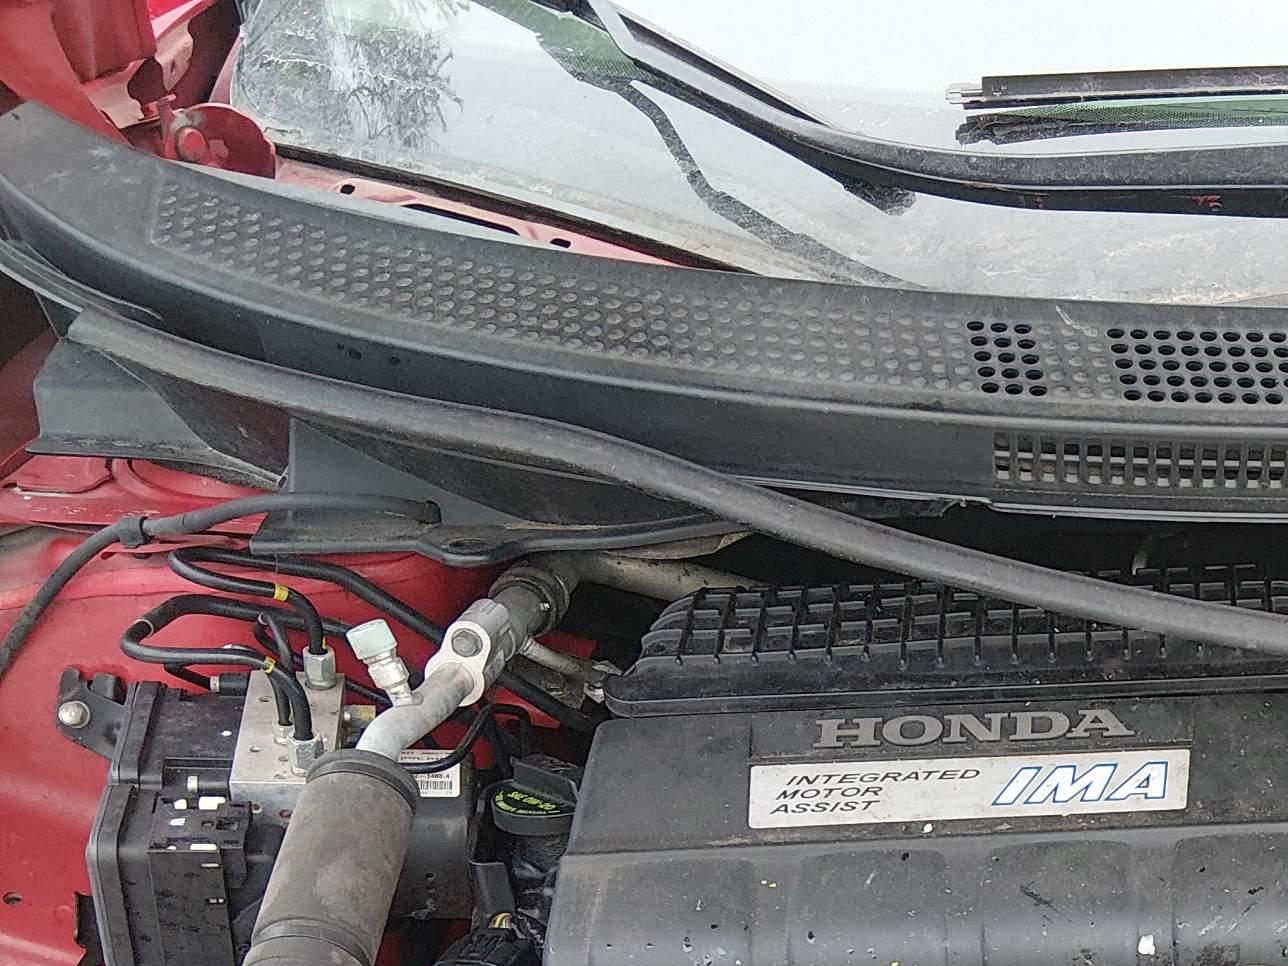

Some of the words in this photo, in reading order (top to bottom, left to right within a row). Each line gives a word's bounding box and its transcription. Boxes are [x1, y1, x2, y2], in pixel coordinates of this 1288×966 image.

[813, 708, 1136, 749] HONDA
[787, 768, 982, 786] INTEGRATED
[991, 760, 1170, 808] IMA
[775, 786, 883, 801] MOTOR
[769, 800, 882, 816] ASSIST
